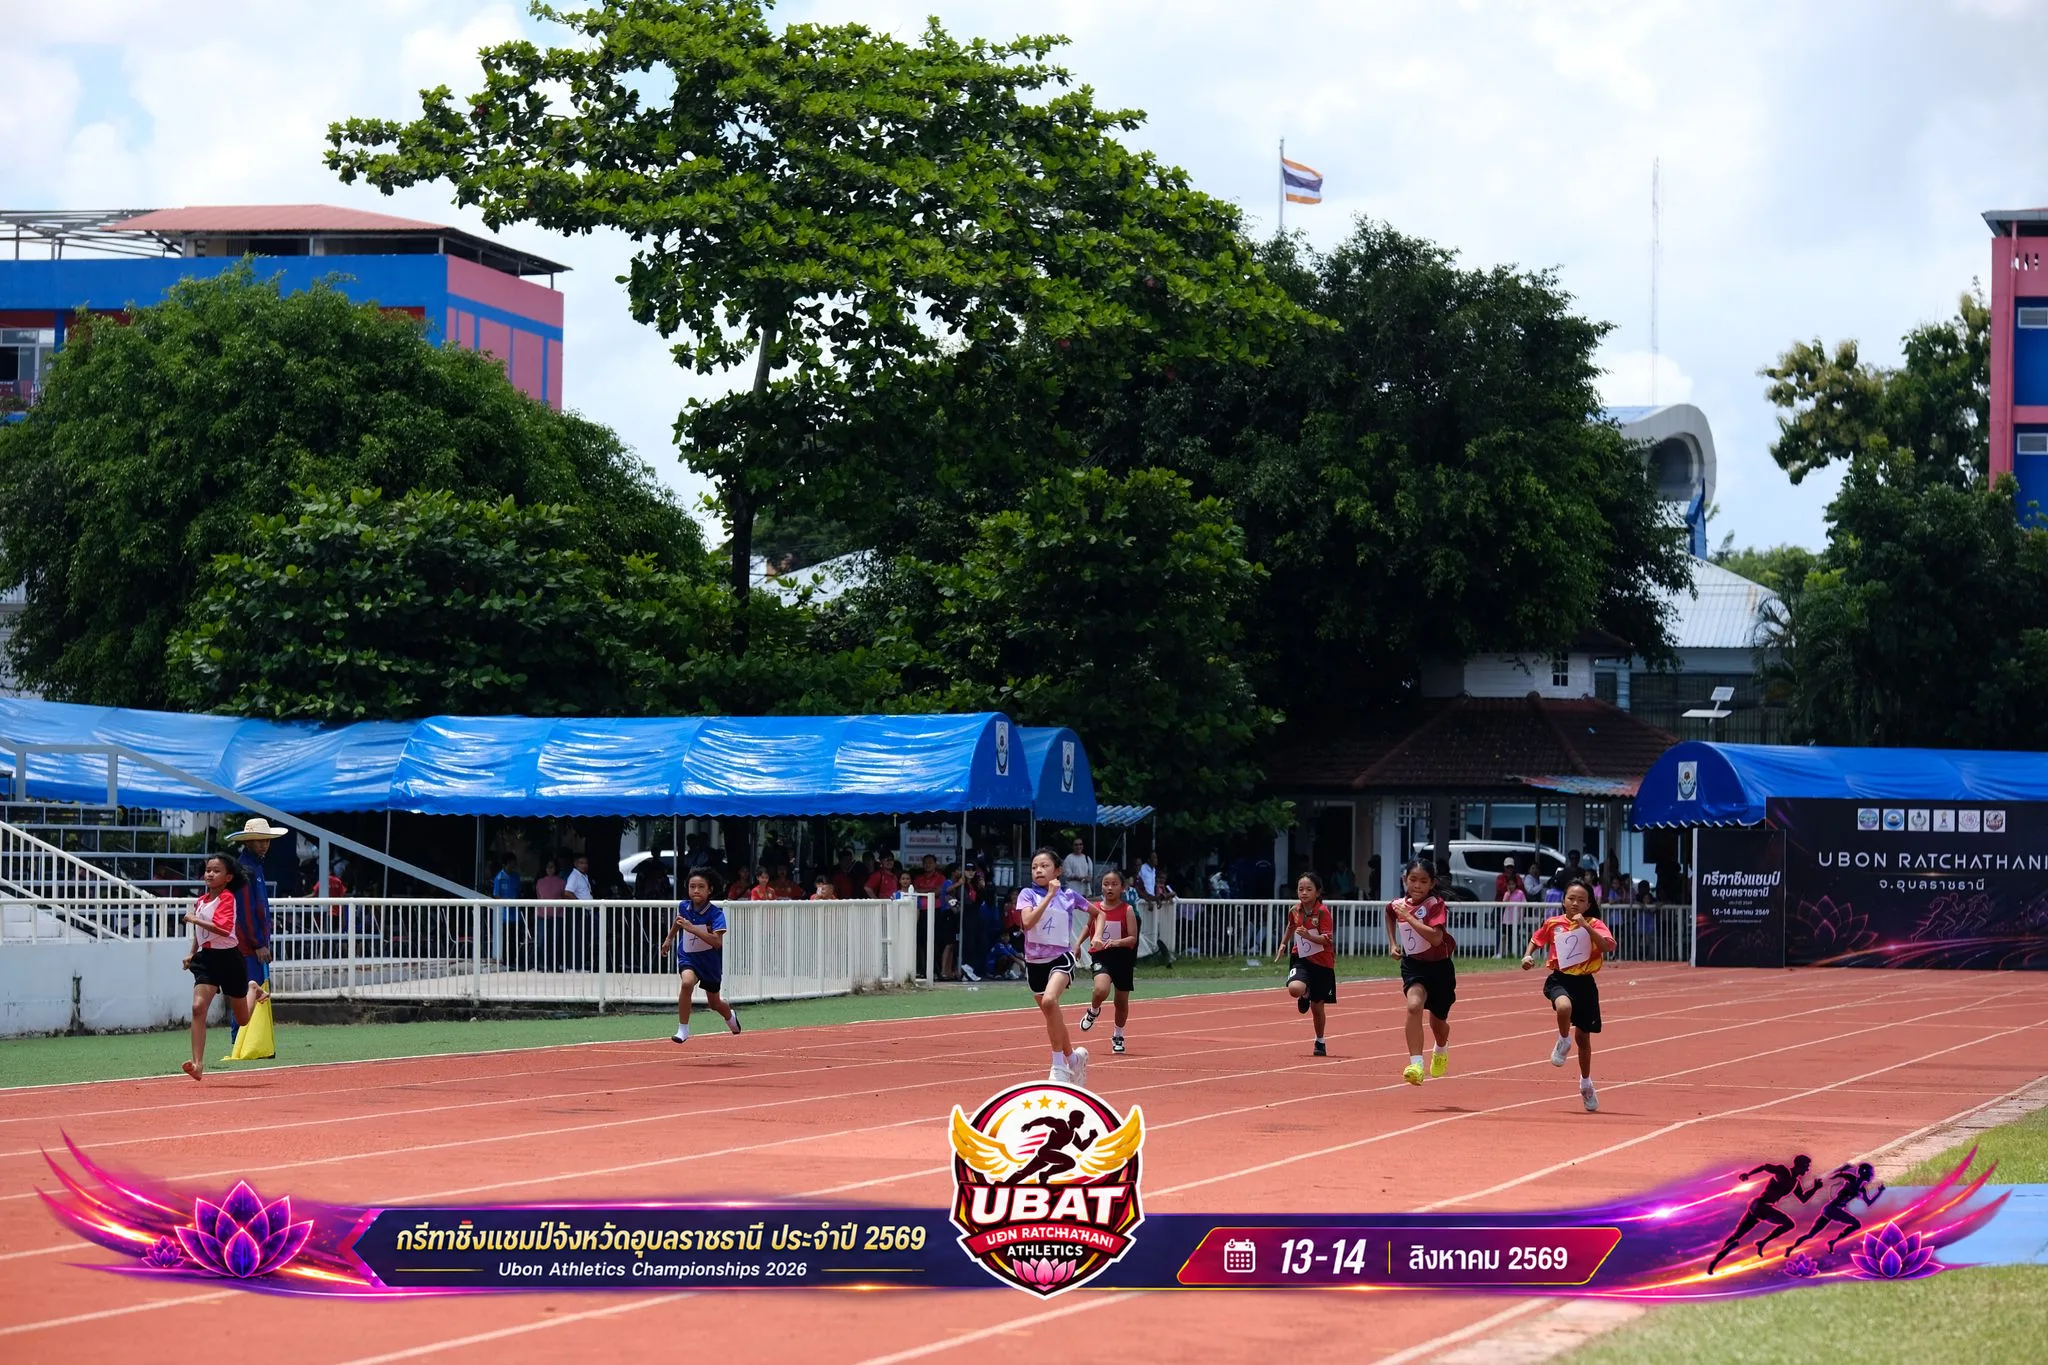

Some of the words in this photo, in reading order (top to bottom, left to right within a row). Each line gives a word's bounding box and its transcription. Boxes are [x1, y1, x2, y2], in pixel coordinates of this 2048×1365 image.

[1818, 851, 1887, 868] UBON
[1898, 852, 2048, 871] RATCHATHANI
[1042, 916, 1055, 935] 4
[1102, 924, 1111, 940] 6
[1405, 928, 1416, 952] 3
[1565, 934, 1583, 960] 2
